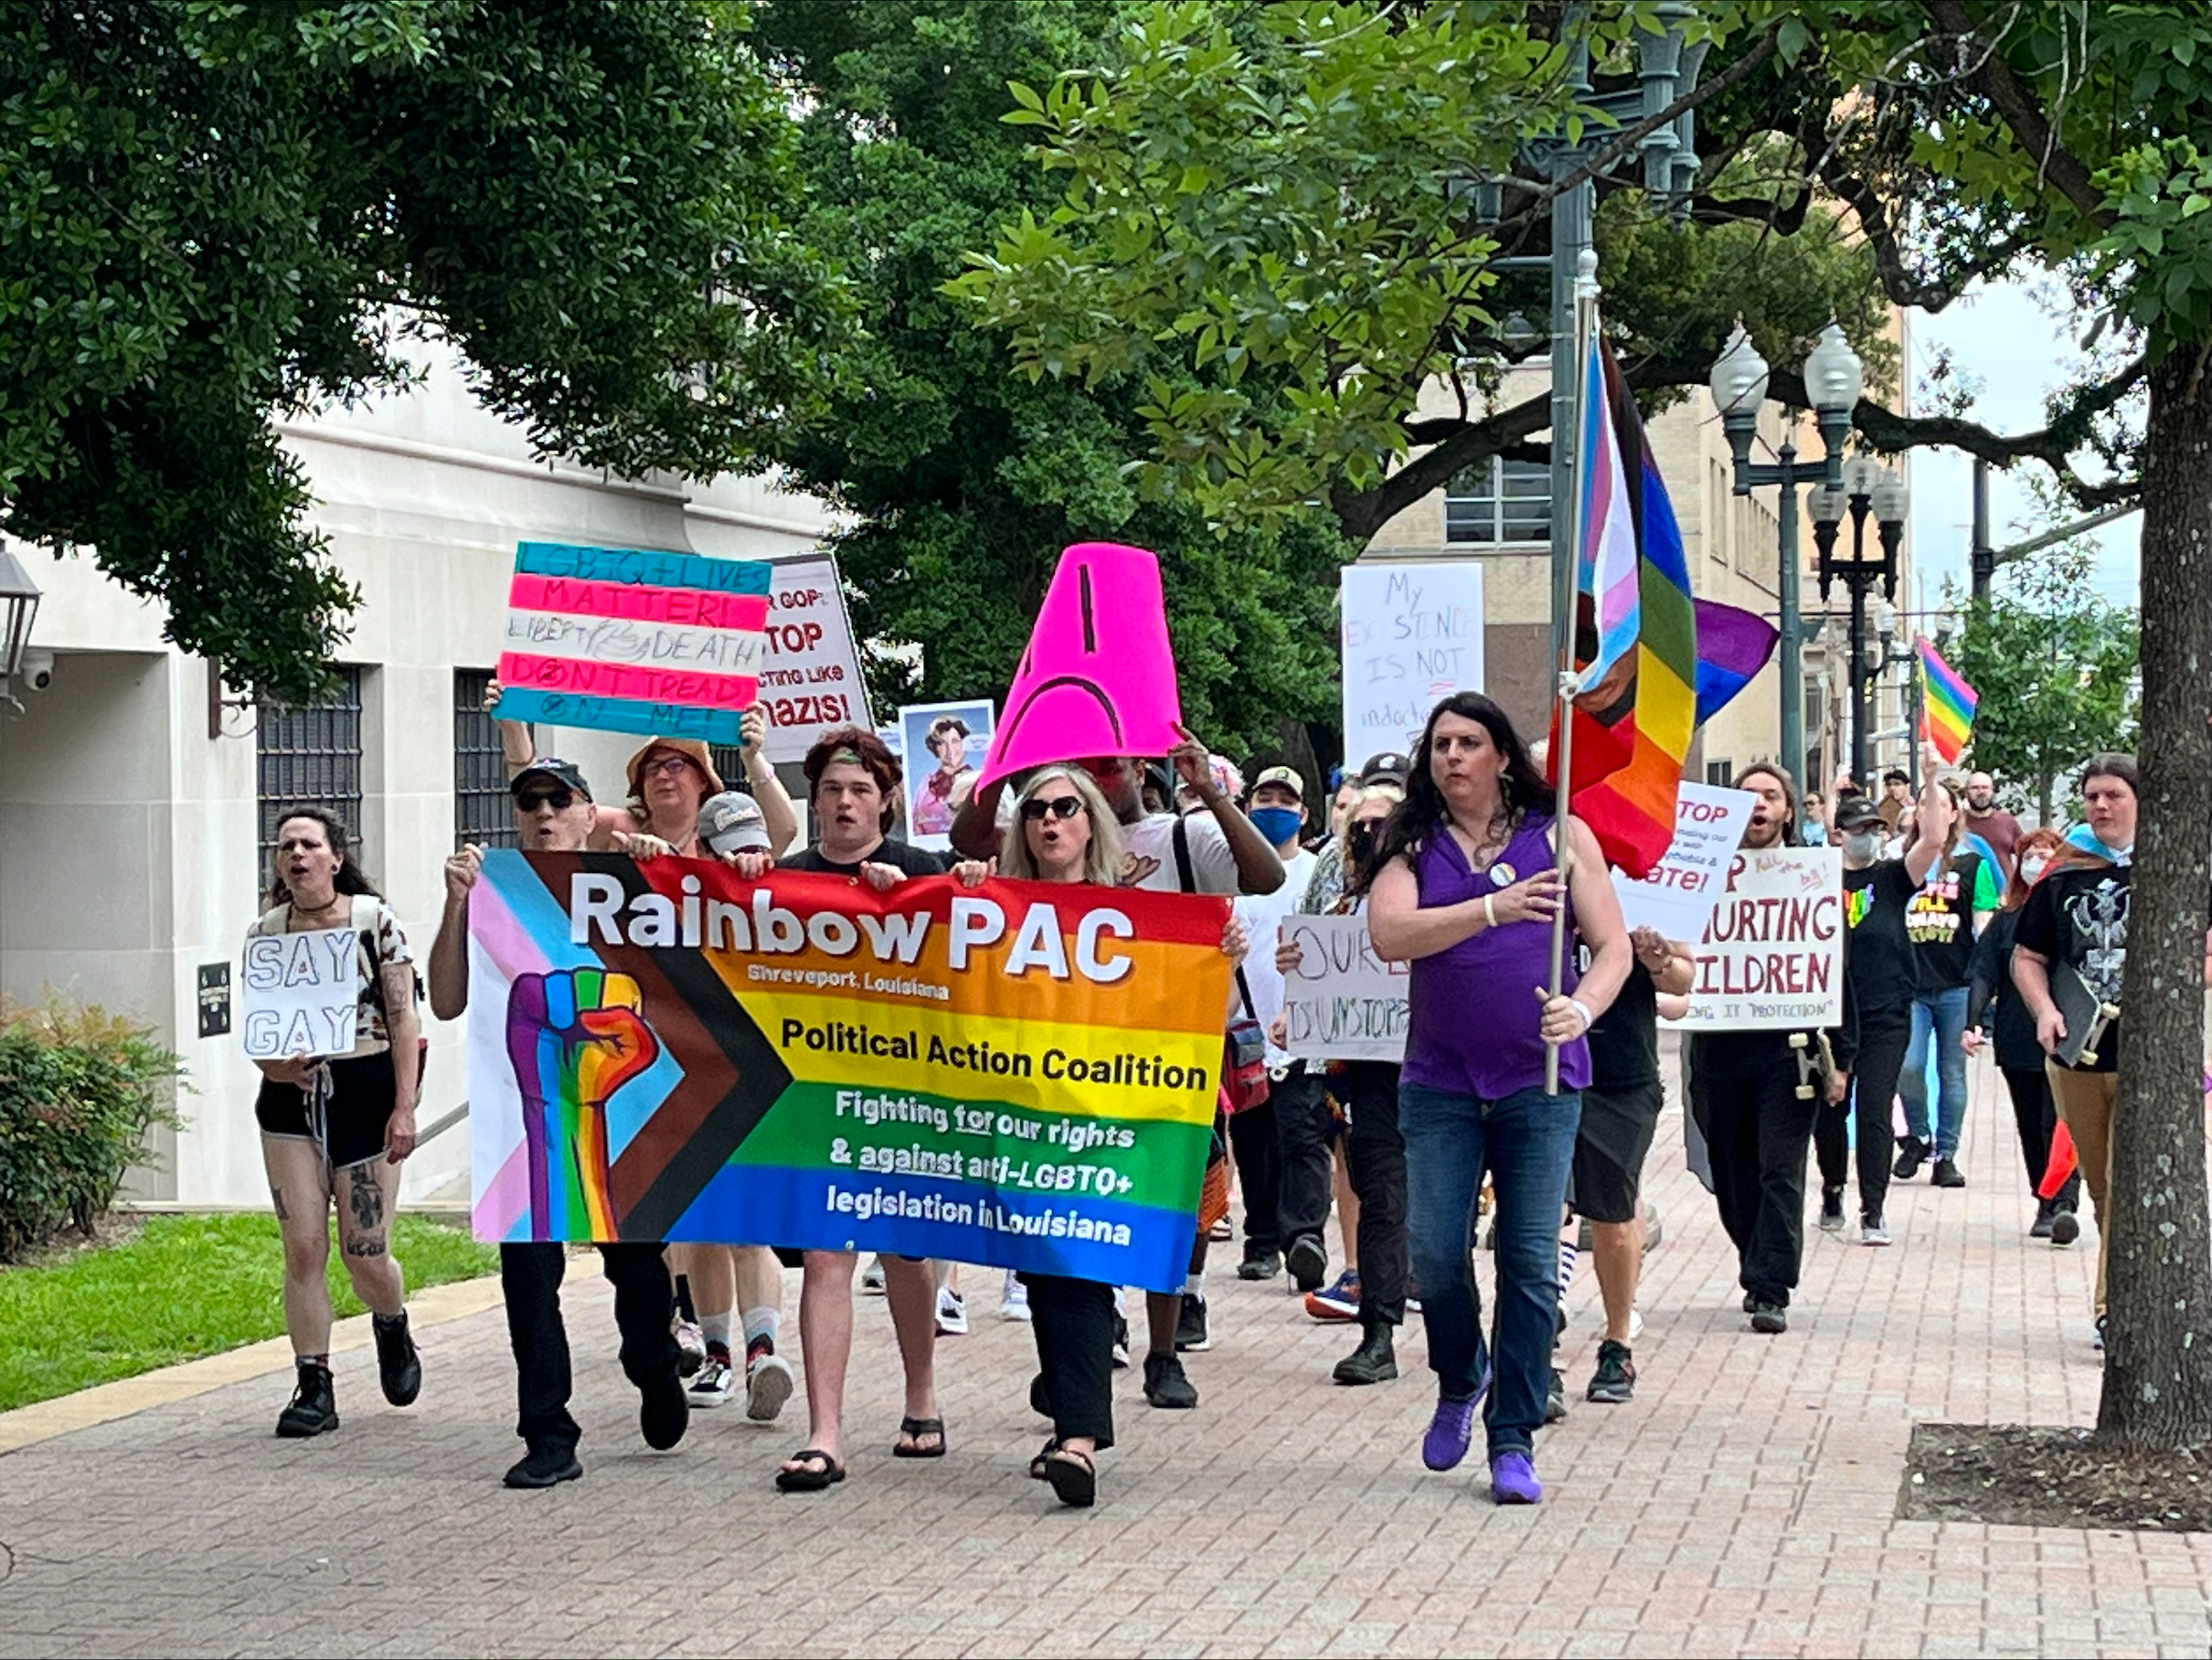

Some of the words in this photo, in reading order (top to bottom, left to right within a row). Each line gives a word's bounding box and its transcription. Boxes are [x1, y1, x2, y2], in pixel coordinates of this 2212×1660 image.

[542, 579, 729, 629] MATTER!
[1385, 571, 1423, 616] My
[651, 629, 757, 666] DEATH
[764, 622, 823, 654] TOP
[646, 672, 741, 702] TREAD
[1364, 652, 1406, 684] IS
[1413, 646, 1466, 677] NOT
[1678, 800, 1728, 824] TOP
[569, 872, 932, 964] Rainbow
[948, 896, 1133, 984] PAC
[1702, 896, 1837, 944] URTING
[248, 931, 356, 990] SAY
[1695, 952, 1831, 995] ILDREN
[864, 974, 950, 1001] Louisiana
[244, 1005, 356, 1057] GAY
[1314, 994, 1411, 1044] UNSTOPP
[782, 1017, 918, 1060] Political
[926, 1034, 1032, 1078] Action
[1041, 1048, 1208, 1091] Coalition
[835, 1090, 949, 1131] Fighting
[954, 1102, 994, 1132] for
[997, 1114, 1040, 1141] our
[1048, 1118, 1135, 1153] rights
[829, 1138, 852, 1165] &
[859, 1144, 963, 1178] against
[826, 1185, 973, 1223] legislation
[997, 1210, 1132, 1247] Louisiana
